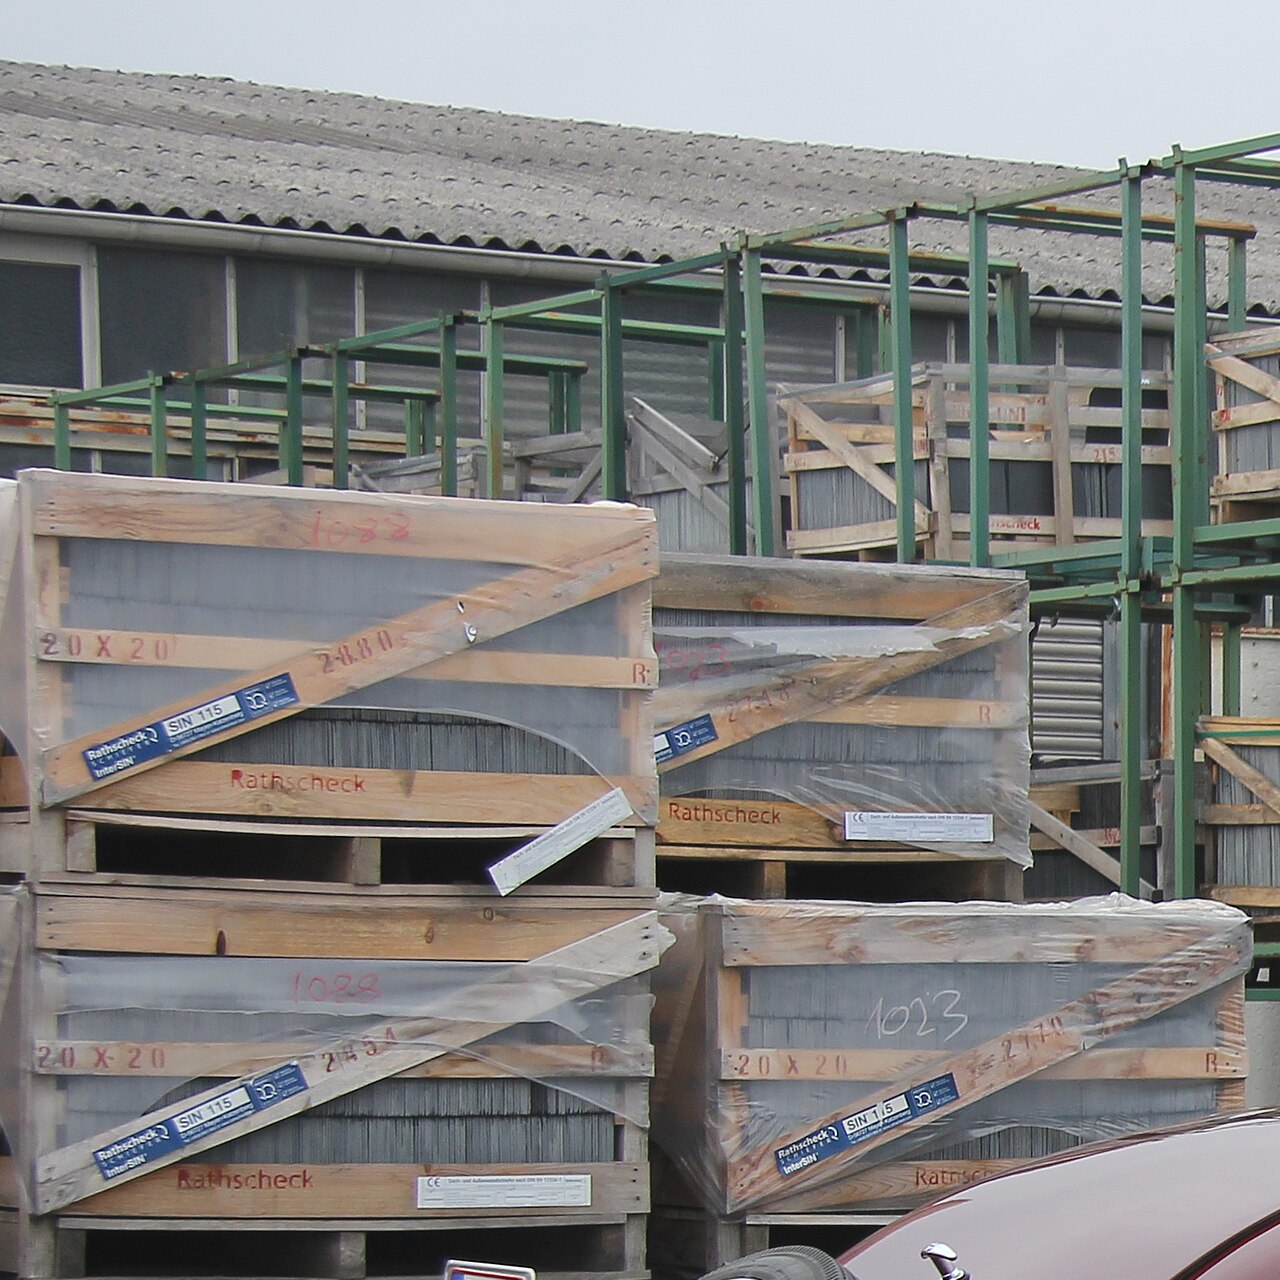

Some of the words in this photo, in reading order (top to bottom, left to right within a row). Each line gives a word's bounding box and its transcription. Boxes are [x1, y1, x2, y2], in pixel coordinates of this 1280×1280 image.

[168, 716, 193, 734] SIN
[198, 704, 223, 720] 115
[87, 731, 149, 762] Rathscheck
[231, 769, 366, 794] Rathscheck
[668, 801, 783, 825] Rathscheck
[787, 1054, 799, 1077] X
[178, 1110, 204, 1130] SIN
[208, 1096, 233, 1116] 115
[847, 1115, 868, 1132] SIN
[98, 1127, 159, 1162] Rathscheck
[778, 1129, 830, 1160] Rathscheck
[177, 1169, 314, 1189] Rathscheck
